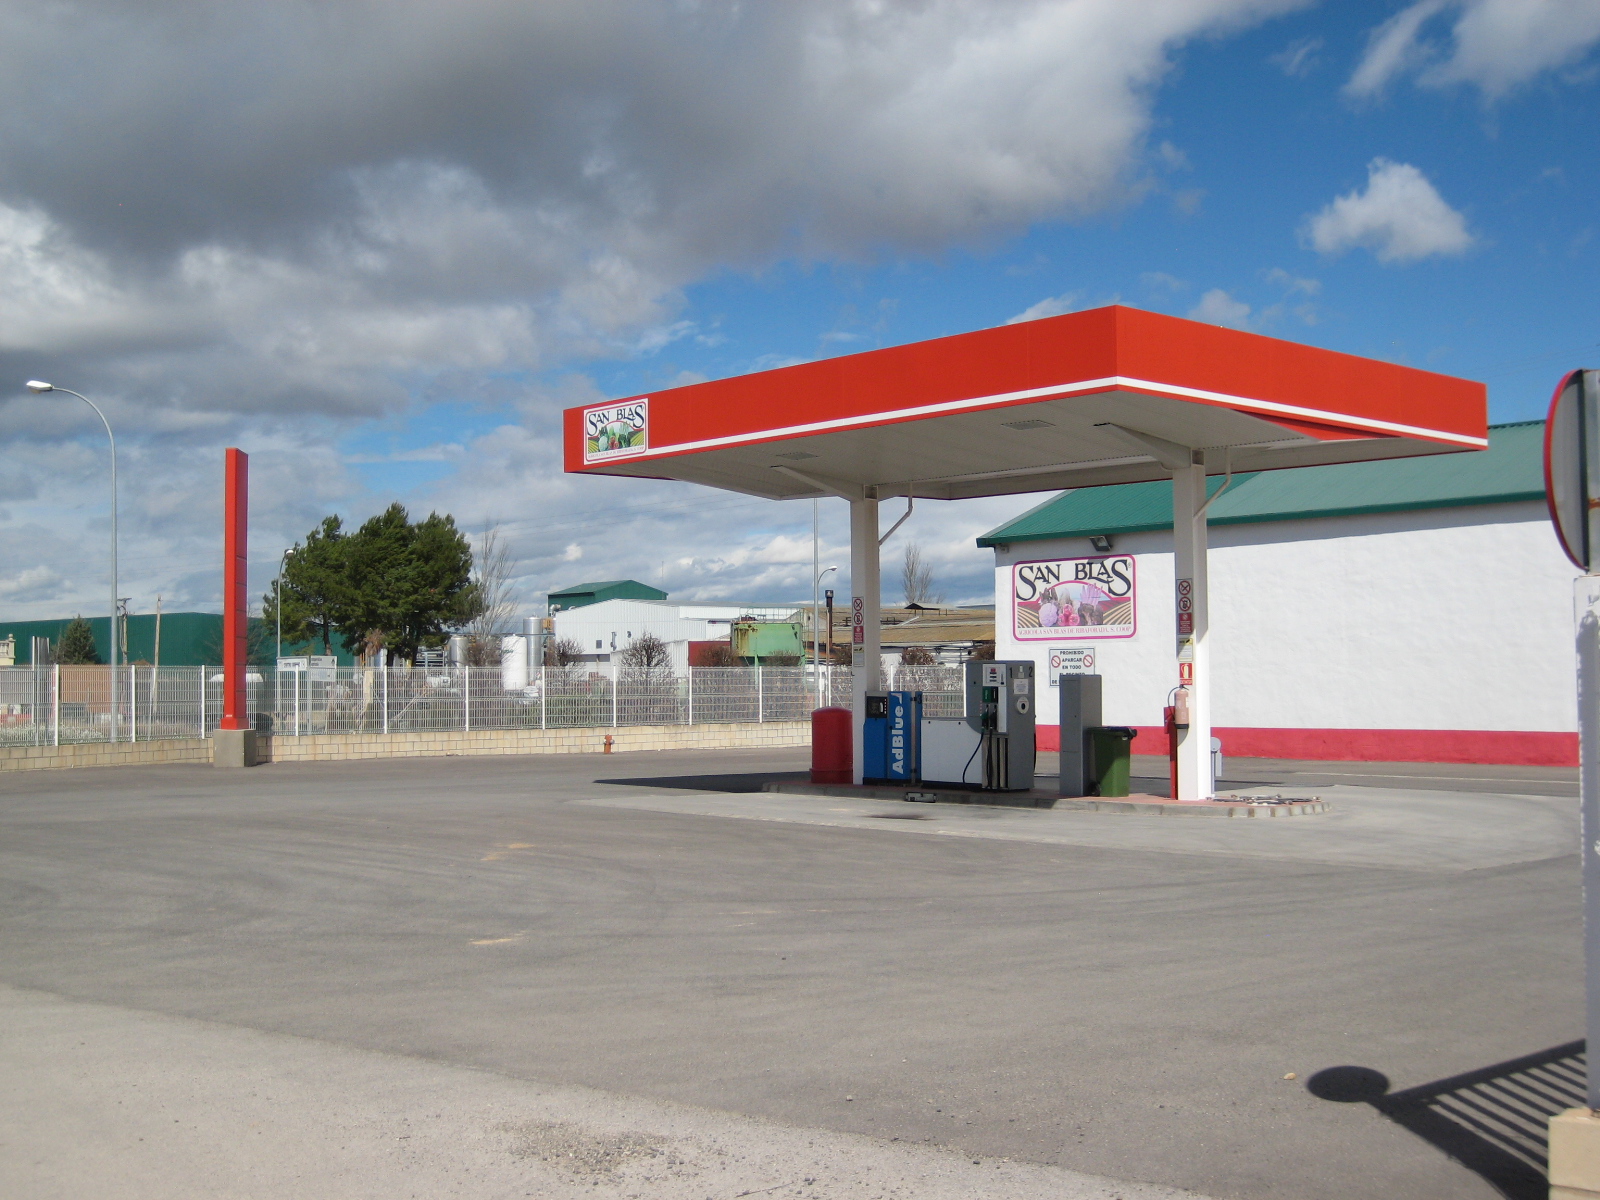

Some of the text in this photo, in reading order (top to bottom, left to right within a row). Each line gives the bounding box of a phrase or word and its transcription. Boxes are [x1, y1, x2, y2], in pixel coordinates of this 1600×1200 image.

[587, 405, 645, 436] SAN BLAS
[1016, 559, 1132, 601] SAN BLAS
[1009, 667, 1013, 678] 1
[1028, 666, 1033, 677] 2
[891, 705, 904, 775] AdBlue
